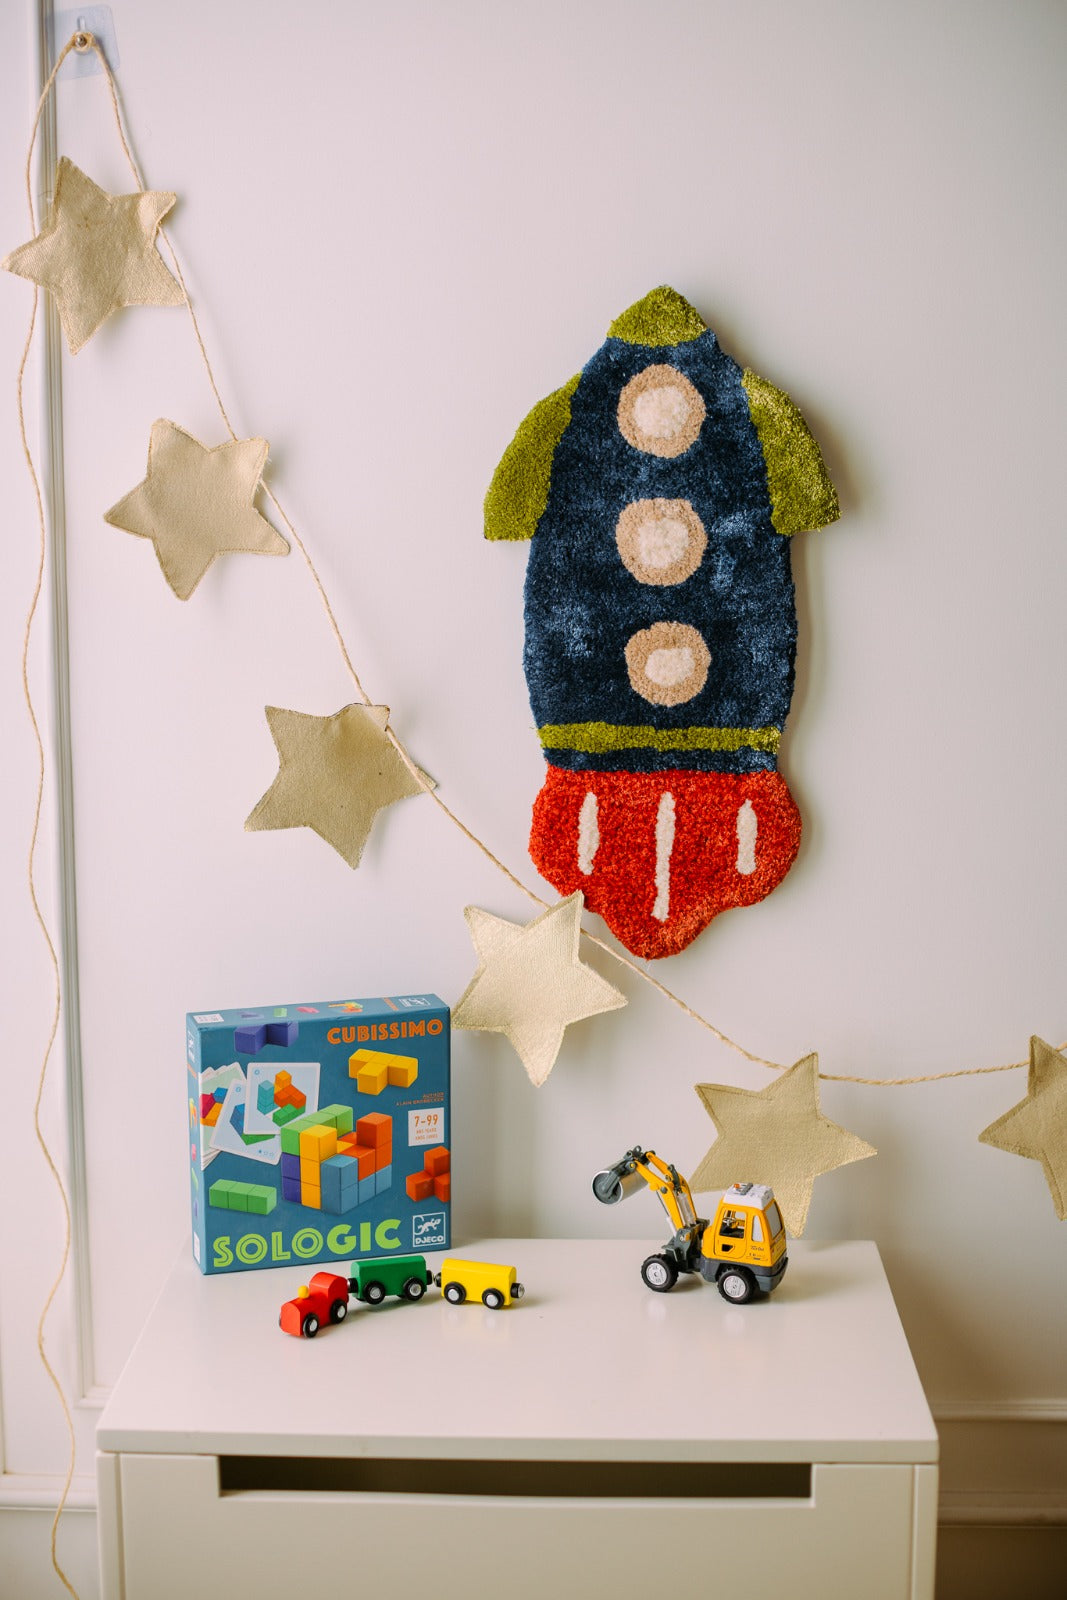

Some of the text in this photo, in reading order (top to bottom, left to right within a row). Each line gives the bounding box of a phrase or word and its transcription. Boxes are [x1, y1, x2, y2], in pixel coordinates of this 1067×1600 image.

[327, 1018, 443, 1045] CUBISSIMO
[414, 1113, 439, 1127] 7-99
[212, 1218, 402, 1268] SOLOGIC
[415, 1235, 444, 1245] DJECO
